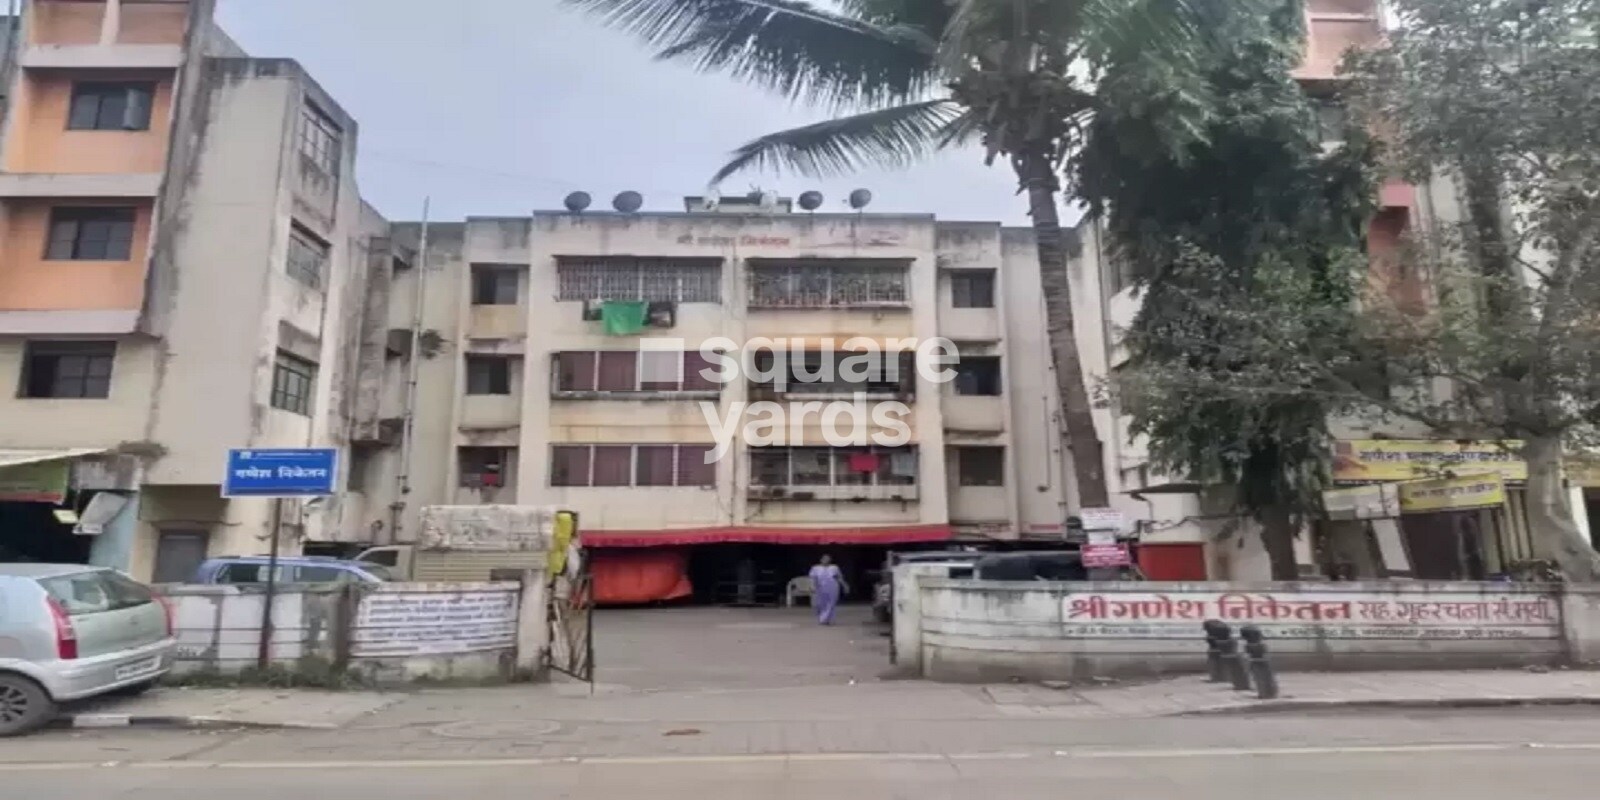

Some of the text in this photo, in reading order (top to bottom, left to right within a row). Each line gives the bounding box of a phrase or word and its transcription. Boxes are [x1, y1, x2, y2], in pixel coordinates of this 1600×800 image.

[235, 465, 328, 479] गणेश निकेतन
[1216, 592, 1350, 620] निकेतन
